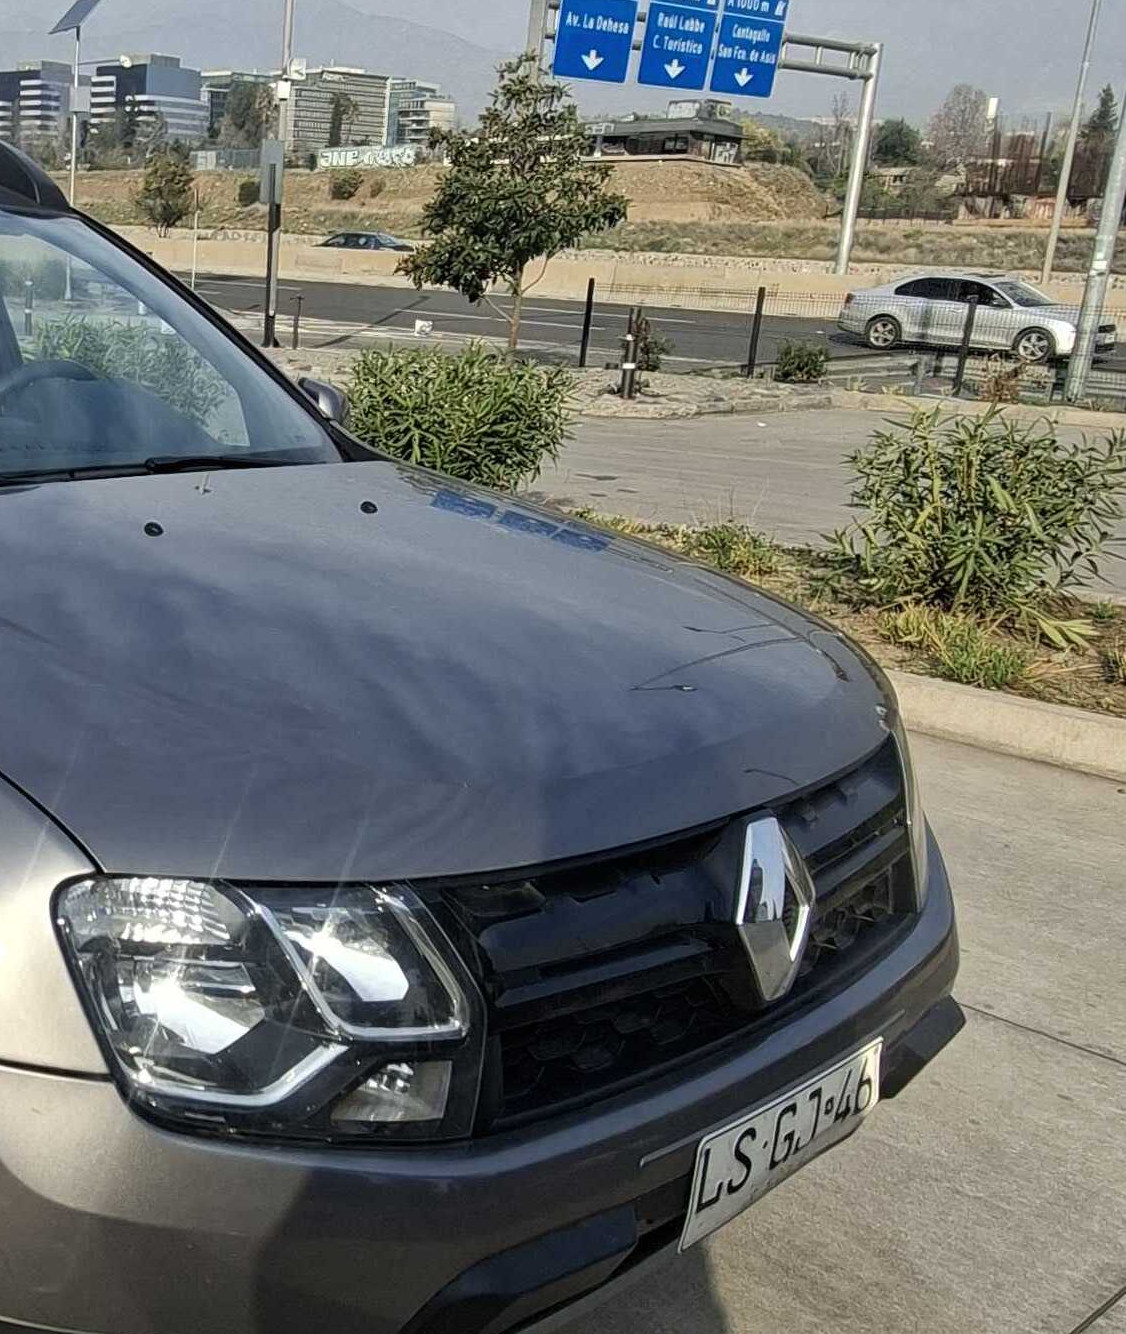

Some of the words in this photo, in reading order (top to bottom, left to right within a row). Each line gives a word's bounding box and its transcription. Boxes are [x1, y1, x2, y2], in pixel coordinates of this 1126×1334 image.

[761, 0, 770, 12] m
[565, 11, 581, 27] Av.
[583, 13, 594, 29] La
[596, 15, 629, 34] Dehesa
[718, 43, 732, 58] San
[749, 48, 759, 62] de
